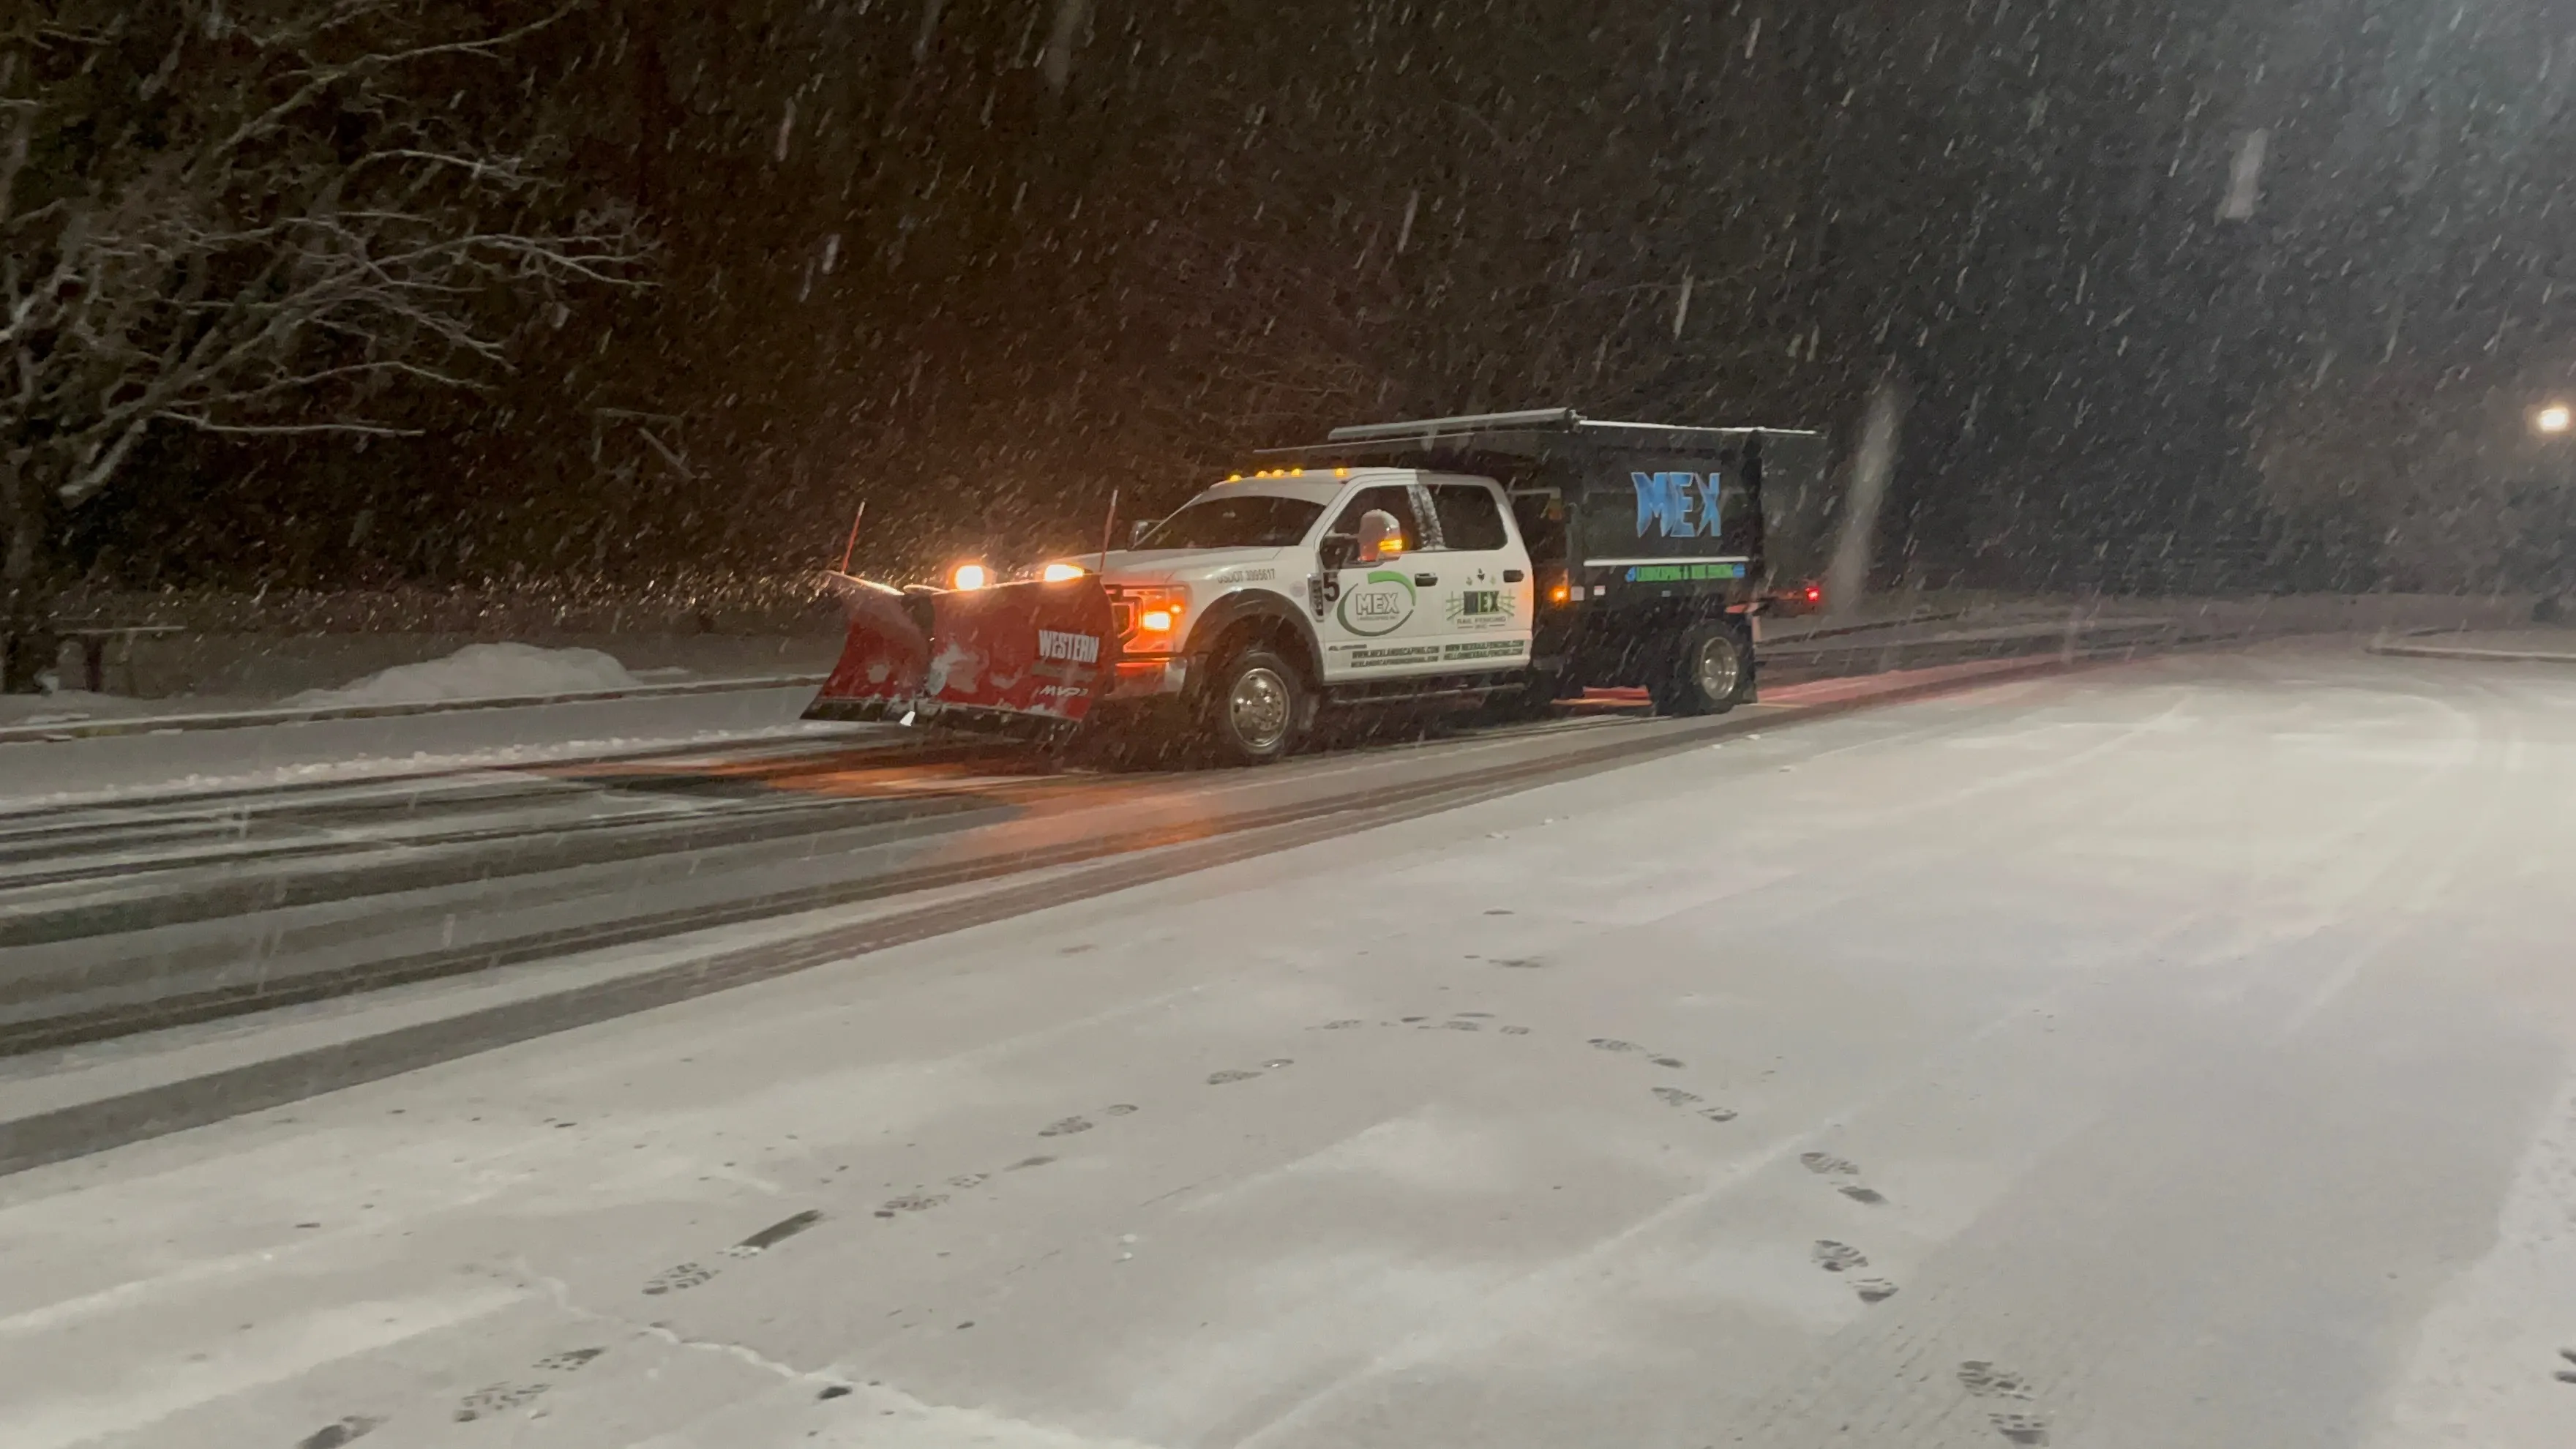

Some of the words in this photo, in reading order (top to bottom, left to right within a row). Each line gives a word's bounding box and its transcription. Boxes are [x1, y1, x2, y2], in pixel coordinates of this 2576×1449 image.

[1630, 471, 1721, 539] MEX
[1323, 572, 1340, 602] 5
[1355, 592, 1399, 615] MEX
[1463, 591, 1499, 615] MEX
[1039, 629, 1099, 664] WESTERN
